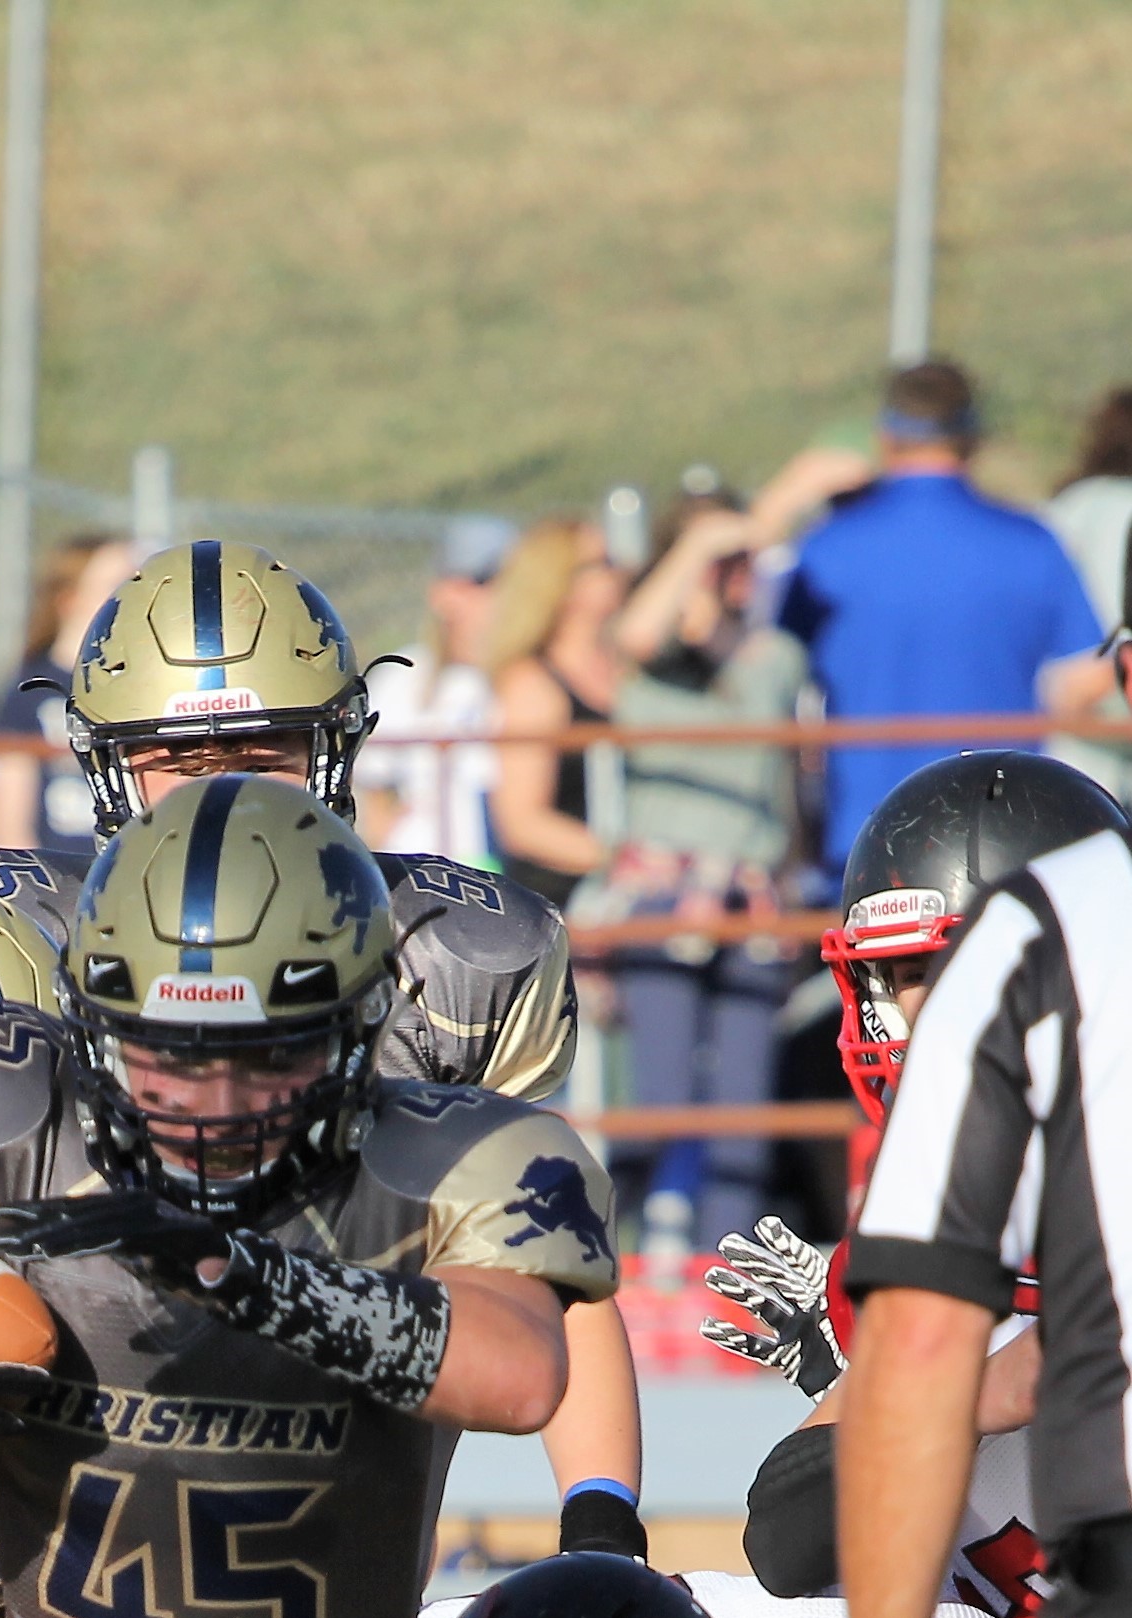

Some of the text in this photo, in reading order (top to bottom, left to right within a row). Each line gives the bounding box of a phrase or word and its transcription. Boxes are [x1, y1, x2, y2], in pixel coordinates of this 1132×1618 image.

[174, 693, 251, 713] Riddell
[870, 895, 919, 918] Riddell
[159, 982, 244, 1002] Riddell
[23, 1380, 351, 1456] HRISTIAN
